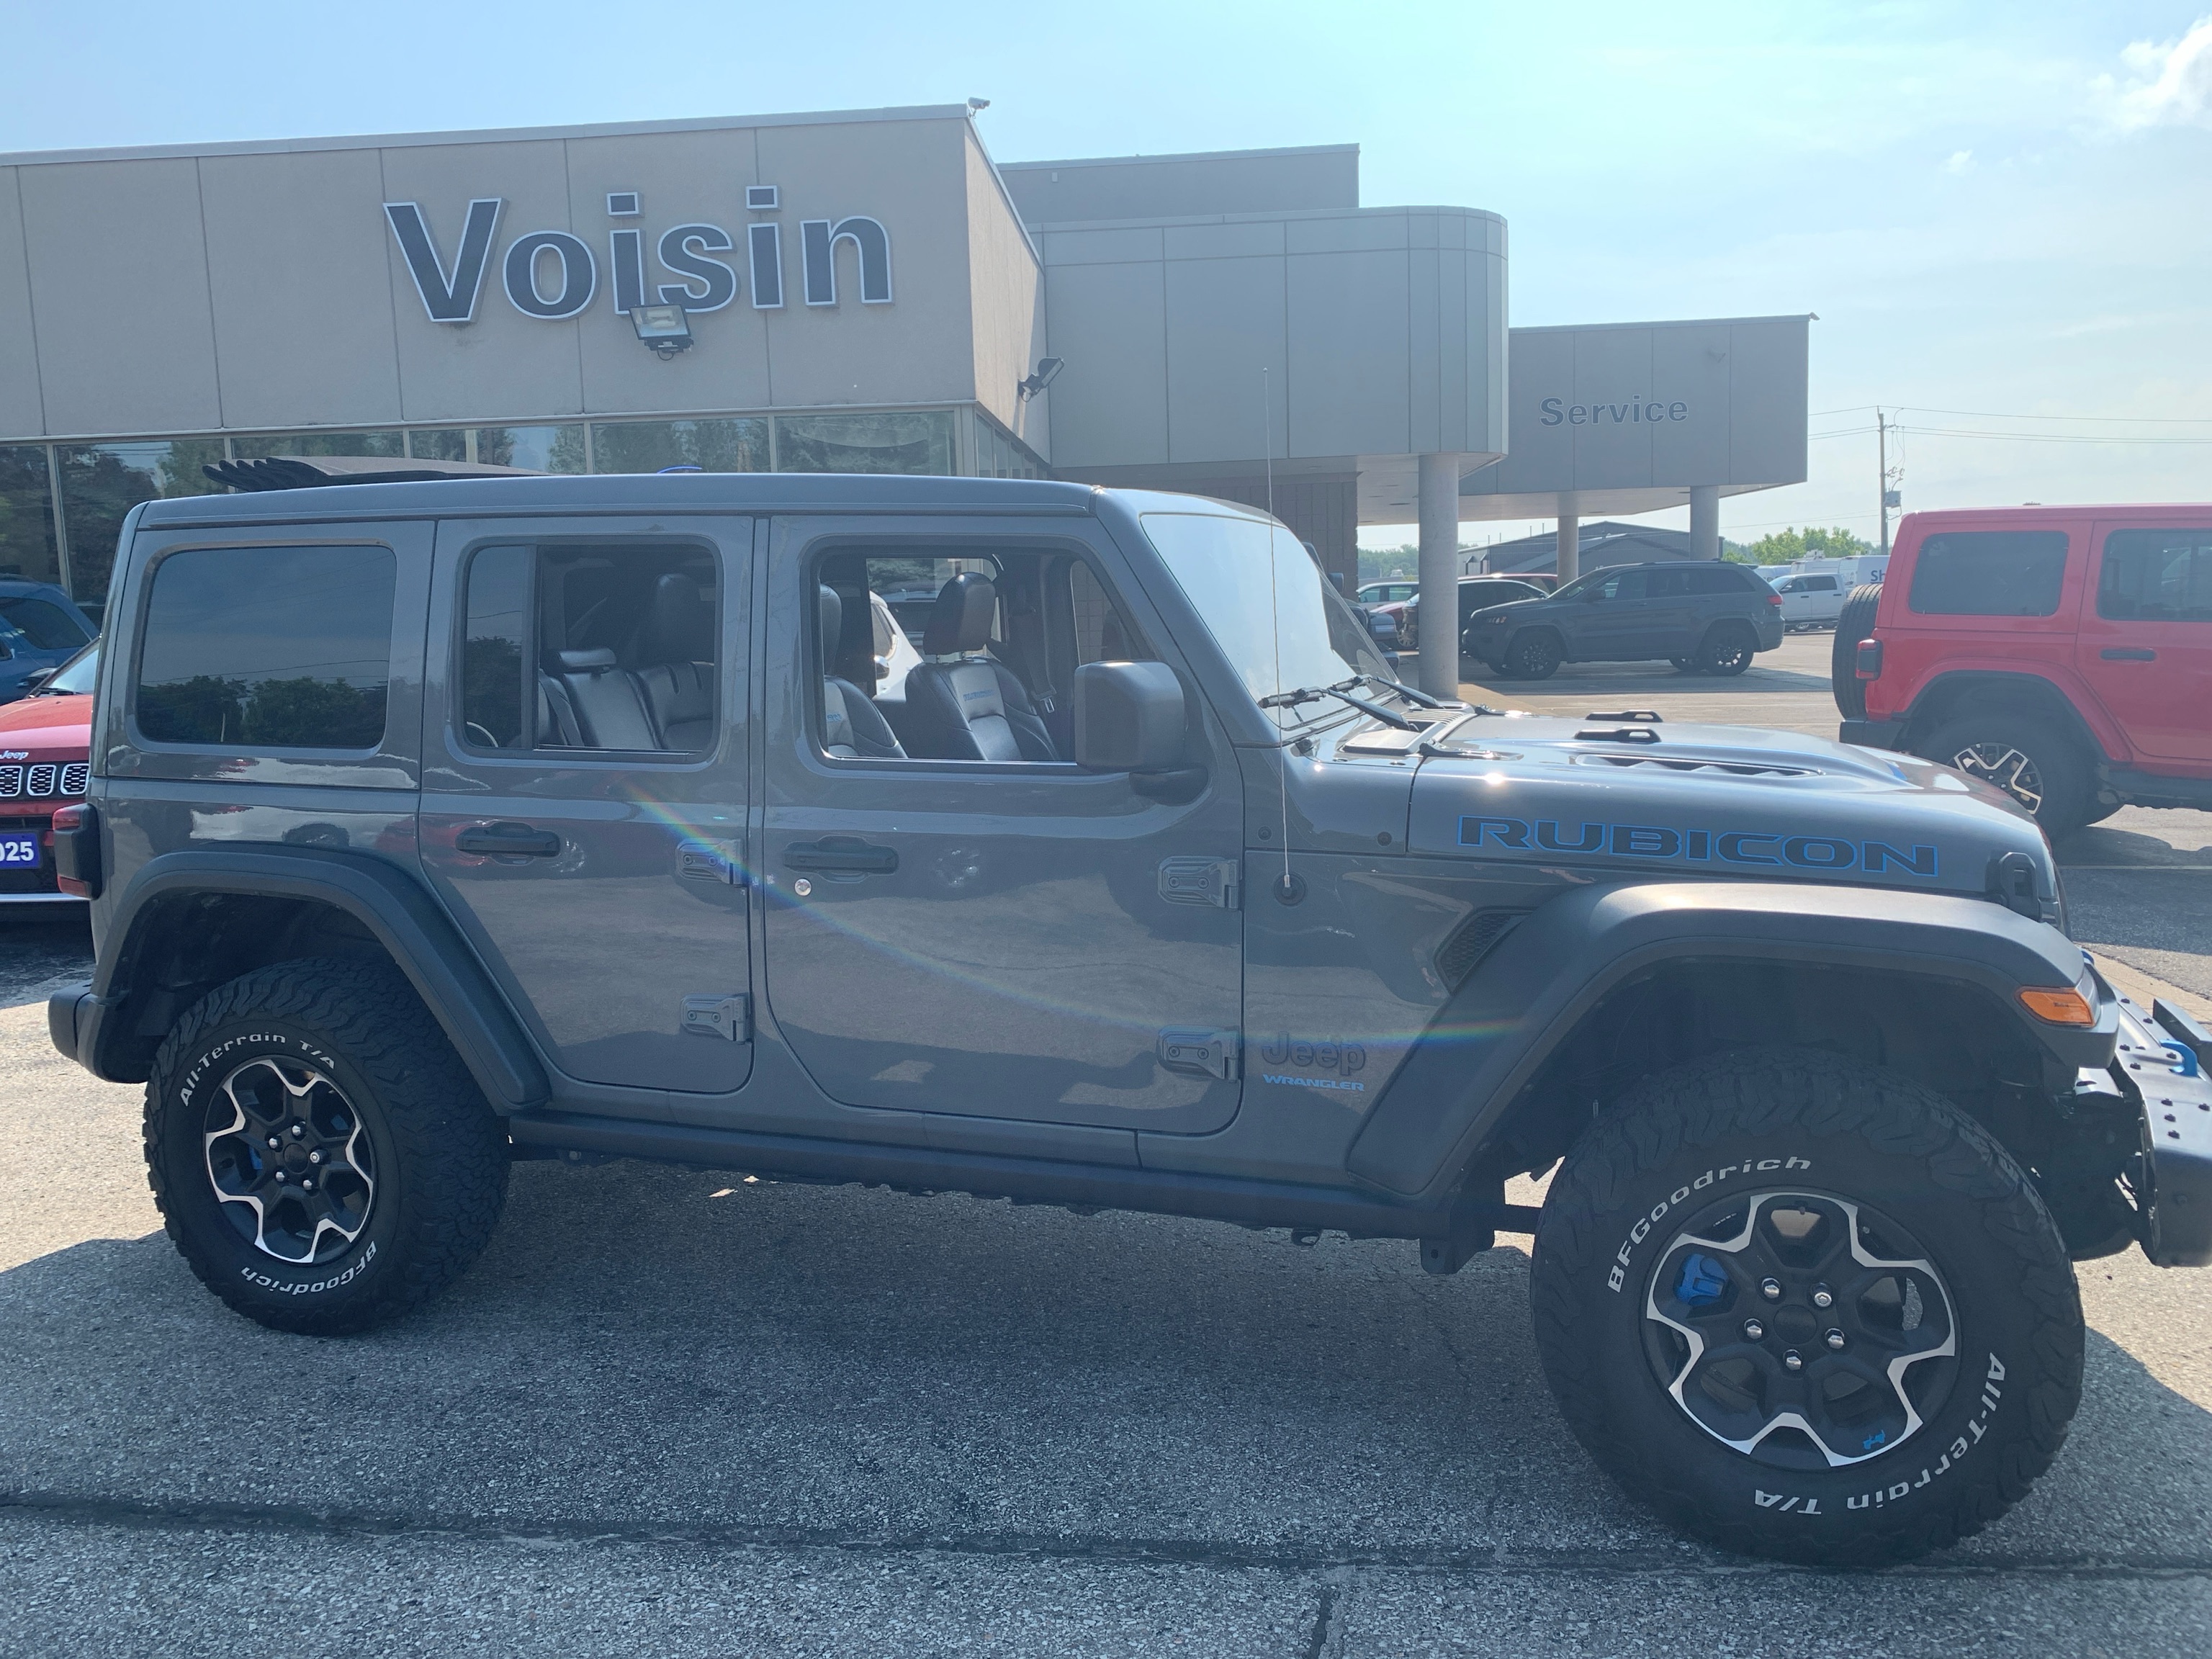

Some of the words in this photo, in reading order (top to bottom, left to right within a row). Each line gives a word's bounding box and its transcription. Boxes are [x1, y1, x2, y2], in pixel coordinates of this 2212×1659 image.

[382, 185, 893, 322] Voisin
[1539, 394, 1689, 427] Service
[0, 750, 29, 760] Jeep
[1457, 815, 1938, 877] RUBICON
[179, 1032, 286, 1107] All-Terrain
[299, 1040, 336, 1069] T/A
[1262, 1030, 1366, 1076] Jeep
[1262, 1074, 1364, 1092] WRANGLER
[1607, 1156, 1811, 1293] BFGoodrich
[241, 1241, 377, 1295] BFGoodrich
[1847, 1352, 2005, 1509] All-Terrain
[1755, 1489, 1822, 1515] T/A
